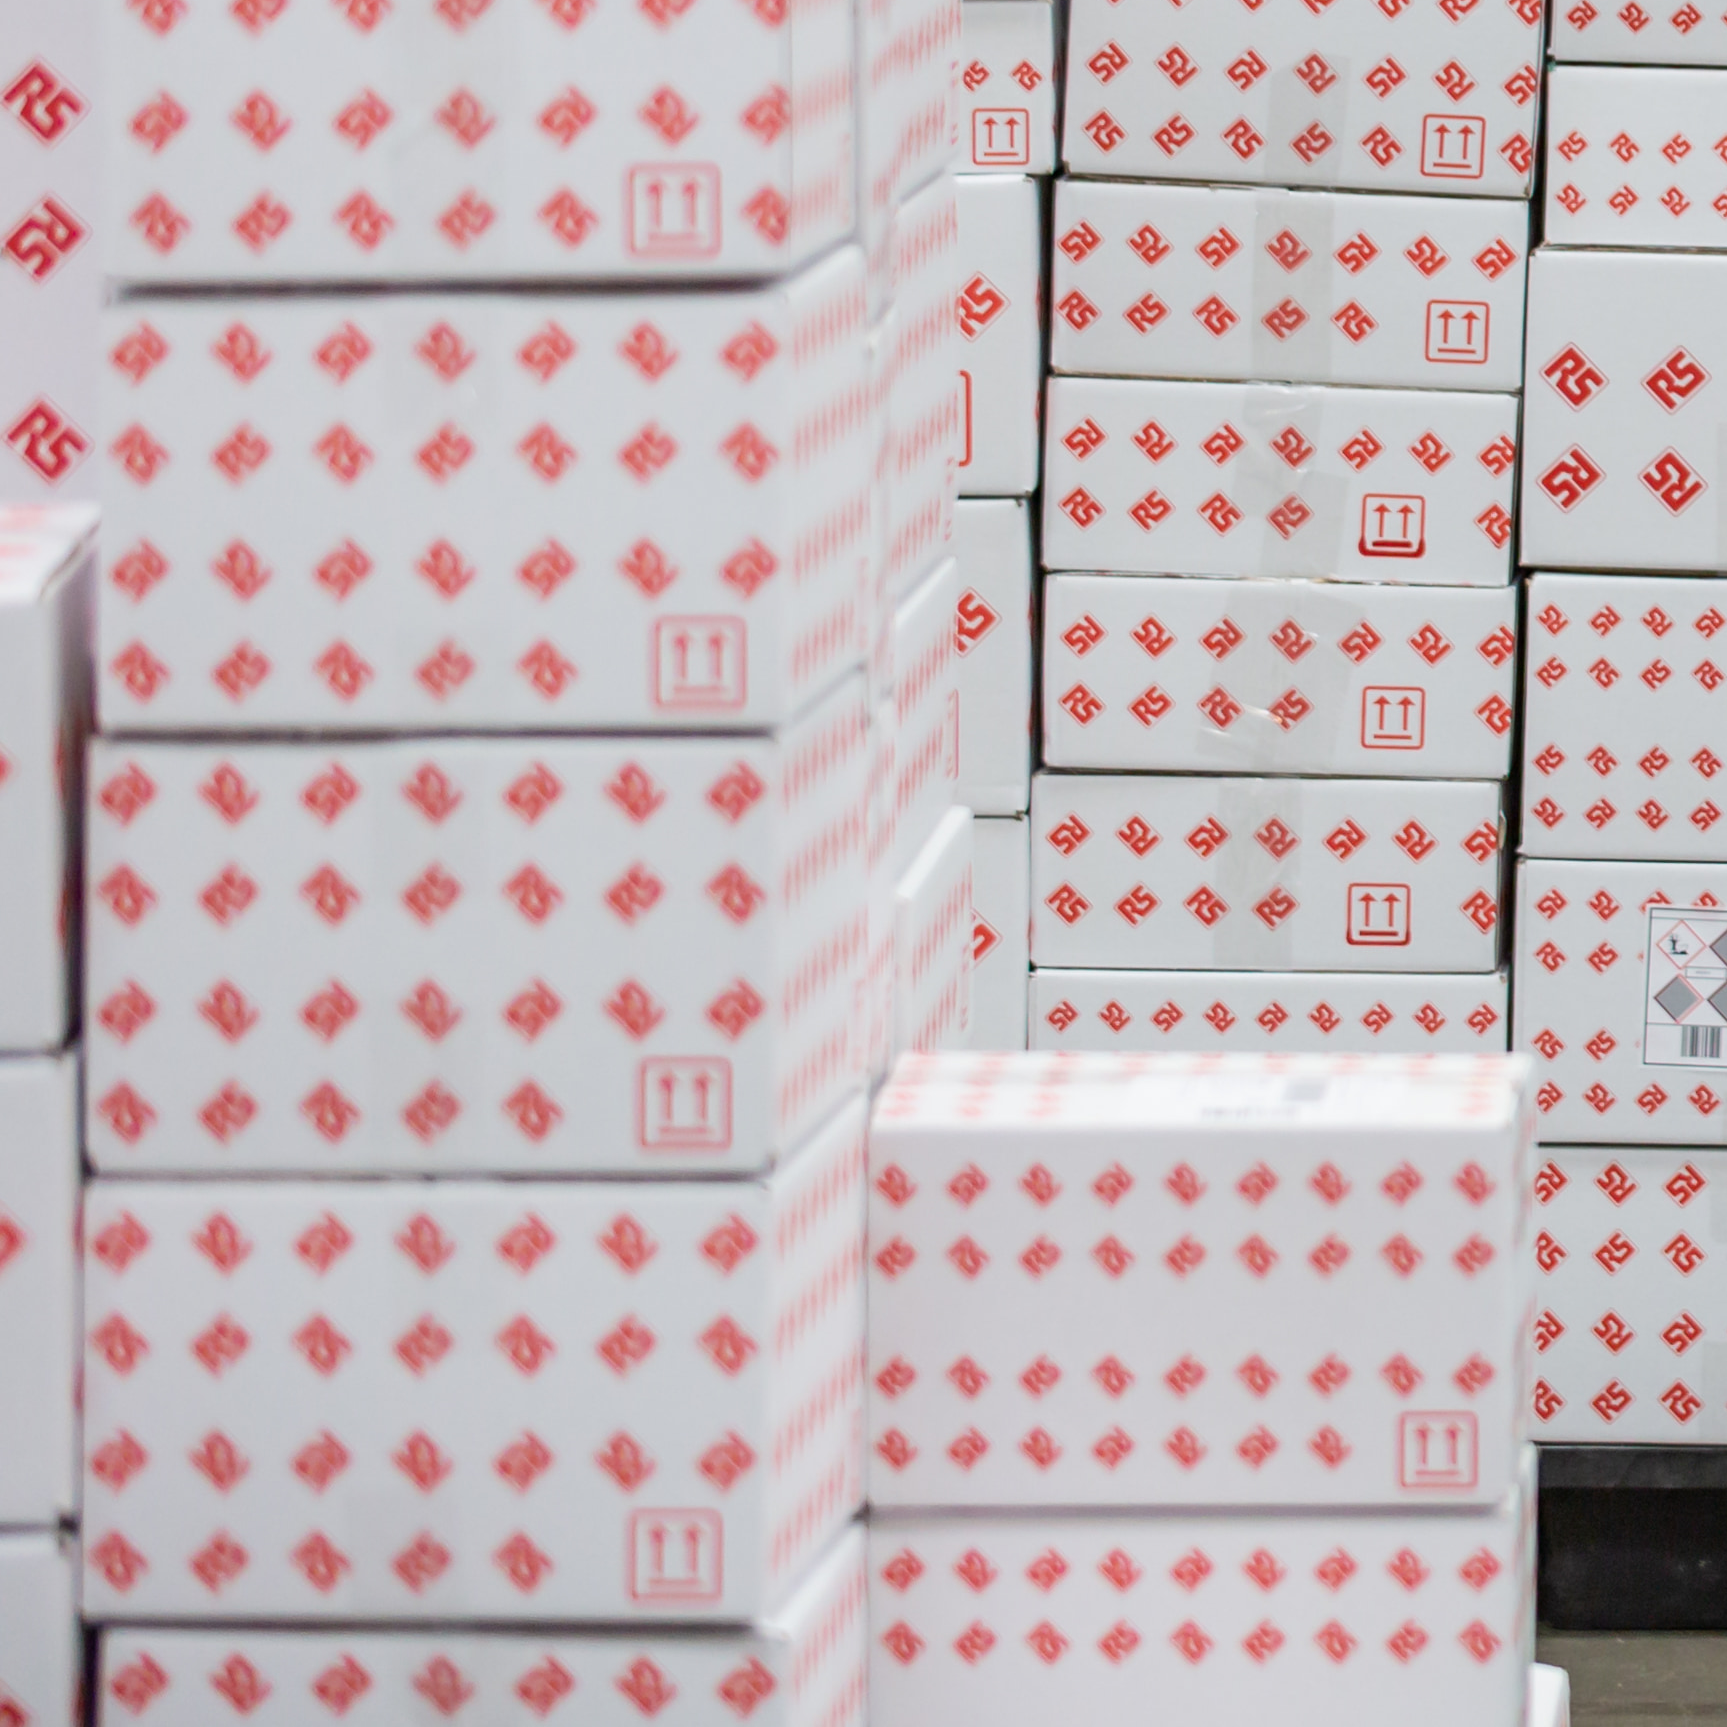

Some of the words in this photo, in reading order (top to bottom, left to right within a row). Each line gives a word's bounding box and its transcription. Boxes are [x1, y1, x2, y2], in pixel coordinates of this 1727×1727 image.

[1012, 60, 1043, 92] RS
[0, 63, 83, 143] RS
[1557, 131, 1588, 162] RS
[1609, 132, 1640, 164] RS
[1661, 133, 1692, 165] RS
[3, 198, 84, 280] RS
[1058, 221, 1102, 263] RS
[1128, 224, 1171, 266] RS
[1197, 227, 1241, 268] RS
[1267, 230, 1310, 271] RS
[1336, 232, 1379, 274] RS
[1405, 235, 1448, 277] RS
[1473, 238, 1517, 280] RS
[1544, 347, 1604, 407] RS
[1645, 350, 1706, 410] RS
[7, 400, 86, 481] RS
[1063, 418, 1106, 460] RS
[1132, 421, 1175, 463] RS
[1202, 423, 1244, 465] RS
[1271, 426, 1313, 468] RS
[1340, 429, 1382, 470] RS
[1409, 432, 1452, 474] RS
[1540, 448, 1601, 509] RS
[1642, 452, 1703, 512] RS
[1061, 614, 1105, 656] RS
[1131, 616, 1175, 658] RS
[1201, 618, 1244, 660] RS
[1271, 620, 1313, 662] RS
[1339, 622, 1382, 663] RS
[1409, 624, 1451, 665] RS
[1535, 657, 1568, 688] RS
[1588, 657, 1620, 690] RS
[1640, 658, 1672, 690] RS
[1693, 659, 1724, 692] RS
[1048, 814, 1091, 856] RS
[1117, 816, 1160, 857] RS
[1186, 816, 1228, 858] RS
[1255, 818, 1298, 859] RS
[1324, 819, 1367, 860] RS
[1394, 820, 1436, 862] RS
[1535, 941, 1567, 972] RS
[1587, 942, 1619, 973] RS
[1046, 1000, 1079, 1032] RS
[1099, 1001, 1131, 1032] RS
[1151, 1001, 1184, 1033] RS
[1204, 1001, 1236, 1033] RS
[1256, 1002, 1289, 1033] RS
[1308, 1002, 1341, 1034] RS
[1361, 1002, 1394, 1034] RS
[1414, 1003, 1446, 1034] RS
[1466, 1003, 1499, 1035] RS
[1595, 1164, 1637, 1205] RS
[1664, 1164, 1706, 1206] RS
